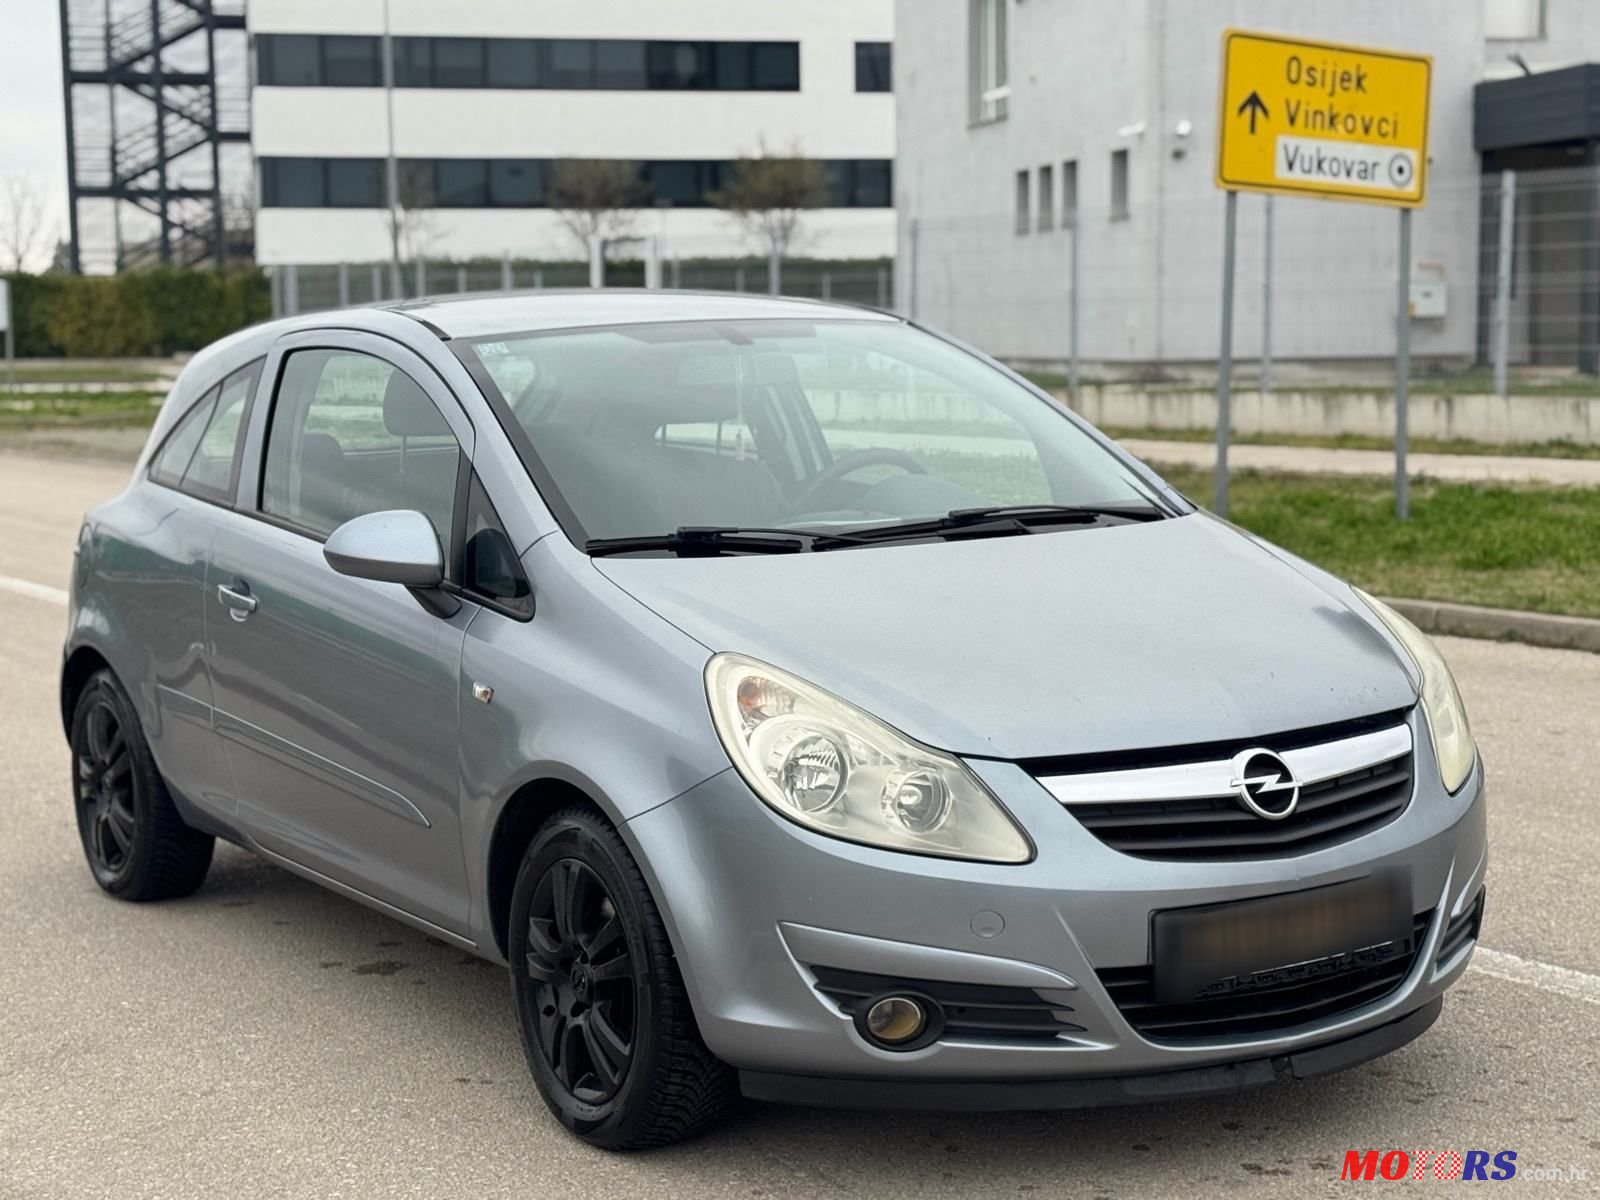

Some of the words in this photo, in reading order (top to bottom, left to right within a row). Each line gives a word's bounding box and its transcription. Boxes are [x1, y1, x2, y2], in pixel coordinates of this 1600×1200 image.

[1286, 55, 1367, 97] Osijek
[1285, 97, 1398, 139] Vinkovci
[1283, 142, 1379, 181] Vukovar
